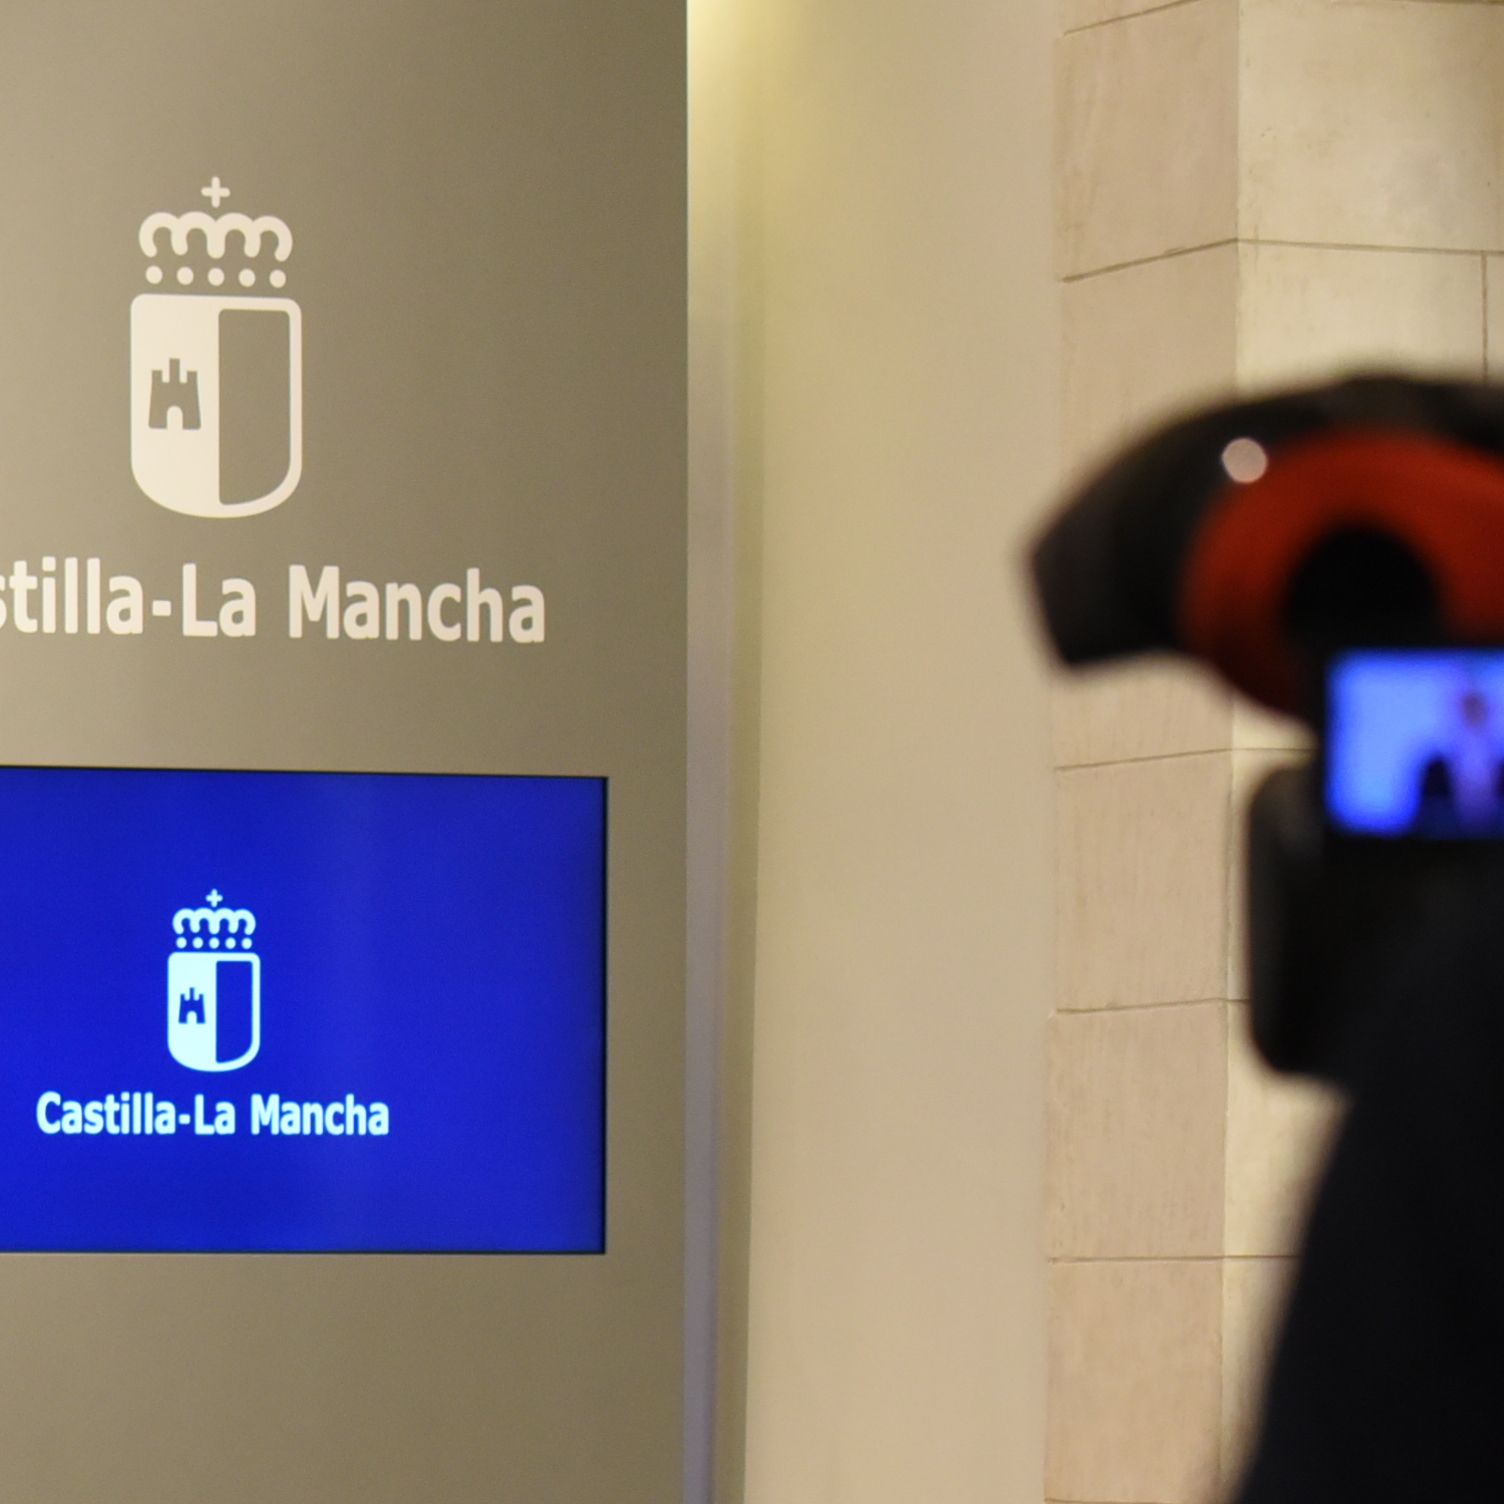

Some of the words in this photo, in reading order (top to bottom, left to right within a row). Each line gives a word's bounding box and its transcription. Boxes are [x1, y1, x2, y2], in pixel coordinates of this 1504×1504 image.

[288, 565, 547, 643] Mancha
[36, 1091, 236, 1136] Castilla-La
[251, 1094, 390, 1137] Mancha
